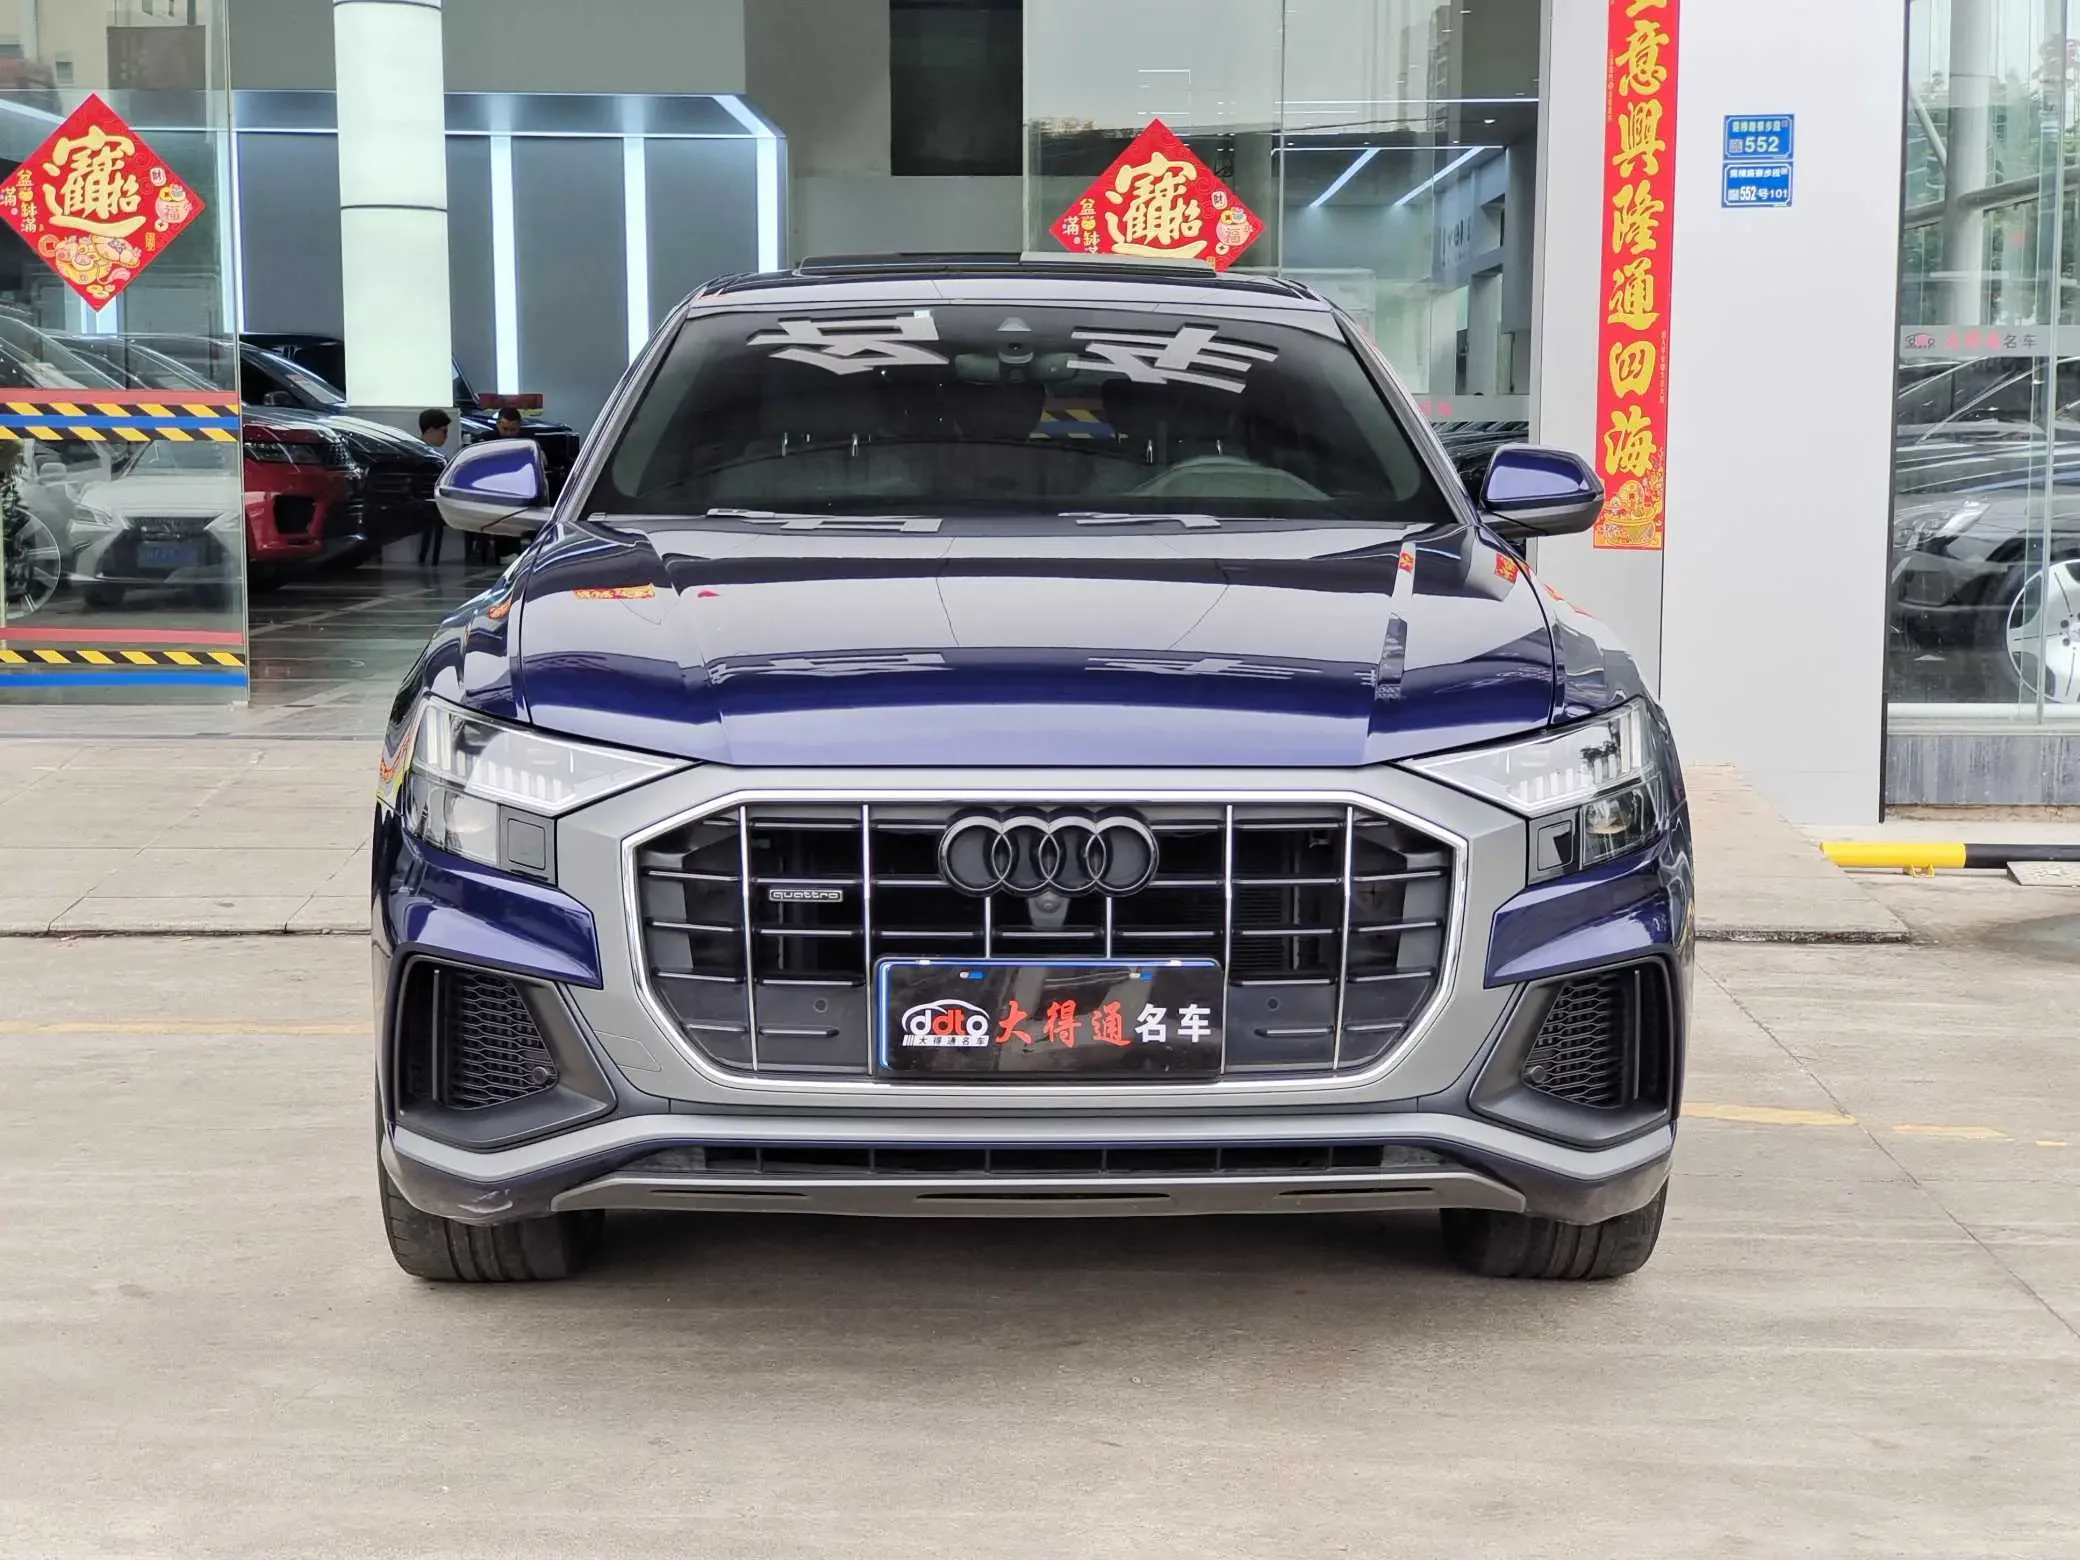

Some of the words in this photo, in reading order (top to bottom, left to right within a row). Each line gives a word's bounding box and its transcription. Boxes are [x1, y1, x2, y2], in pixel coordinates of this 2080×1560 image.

[1745, 136, 1779, 152] 552
[773, 891, 839, 901] quattro
[910, 1009, 989, 1036] ddto
[996, 999, 1212, 1048] 大得通名车
